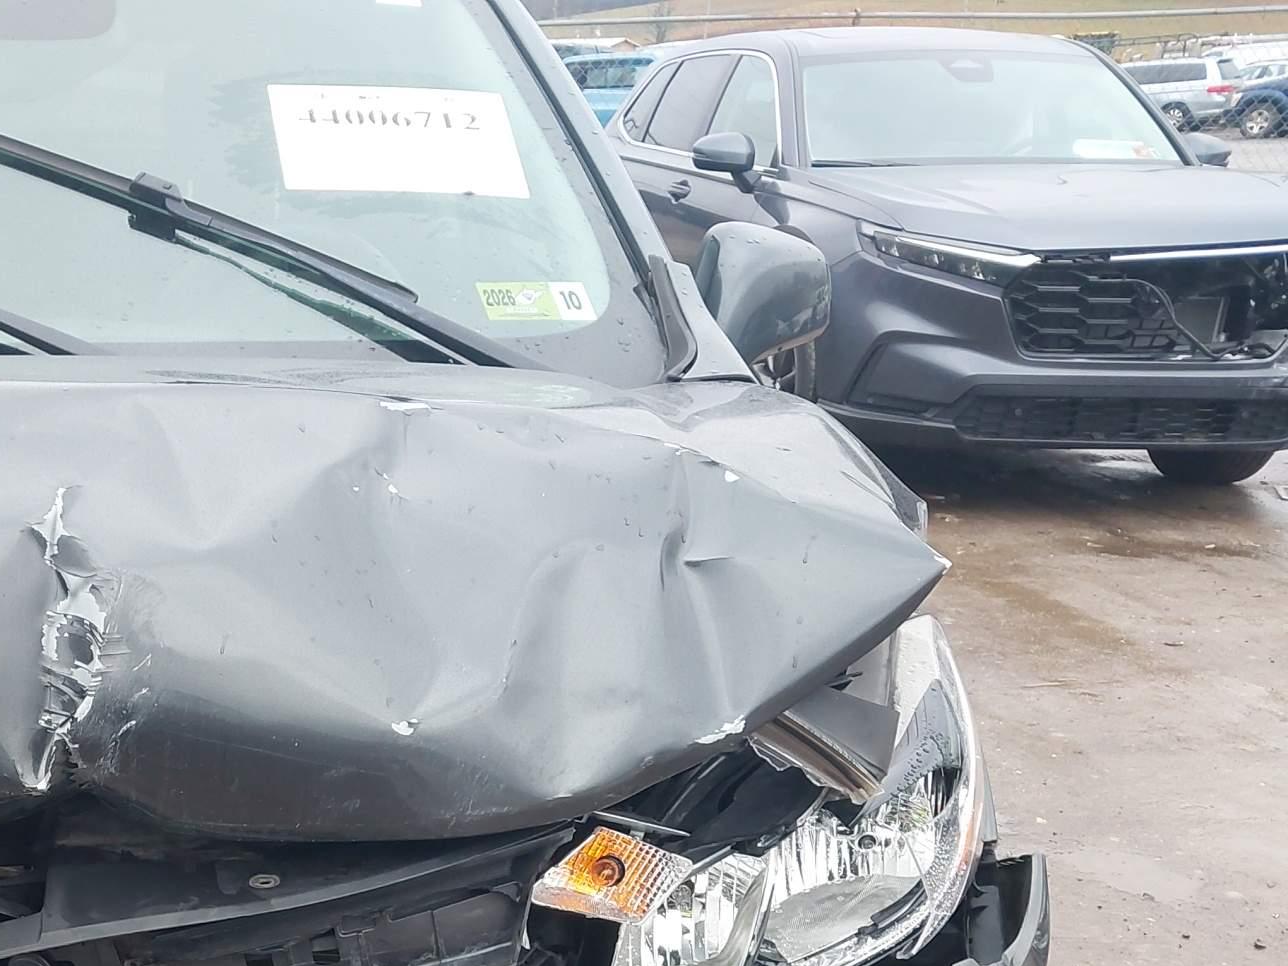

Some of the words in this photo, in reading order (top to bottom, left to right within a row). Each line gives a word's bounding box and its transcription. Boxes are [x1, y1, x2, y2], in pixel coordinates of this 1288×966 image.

[298, 108, 481, 130] 44006712
[483, 289, 517, 307] 2026
[559, 290, 582, 310] 10
